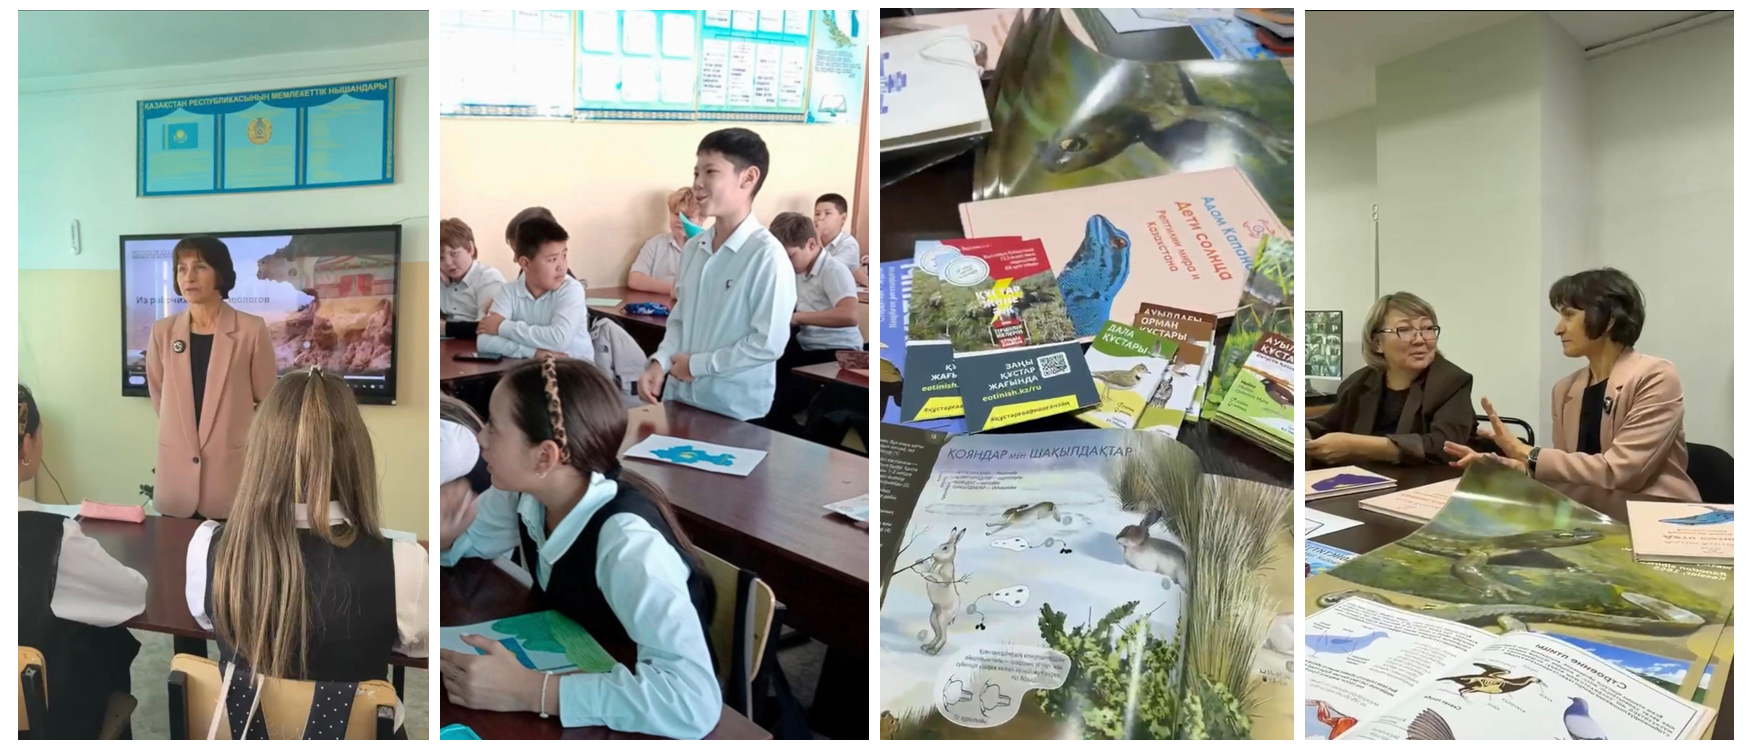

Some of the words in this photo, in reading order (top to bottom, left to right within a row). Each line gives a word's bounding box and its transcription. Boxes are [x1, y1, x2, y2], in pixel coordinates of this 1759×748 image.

[144, 100, 188, 111] ҚАЗАҚСТАН
[188, 93, 270, 107] РЕСПУБЛИКАСЫНЫҢ
[271, 87, 327, 100] МЕМЛЕКЕТТІК
[1156, 209, 1182, 248] Рептилии
[1177, 249, 1197, 273] мира
[1175, 201, 1203, 231] Дети
[1196, 232, 1234, 281] солнца
[1201, 196, 1228, 226] Адам
[1222, 227, 1254, 272] Капано
[1146, 221, 1180, 273] Казахстана
[136, 296, 148, 304] Из
[1108, 322, 1135, 338] ДАЛА
[1140, 316, 1179, 330] ОРМАН
[1102, 332, 1149, 355] ҚҰСТАРЫ
[1005, 358, 1034, 370] ЗАҢЫ
[1000, 367, 1037, 381] ҚҰСТАР
[988, 375, 1039, 392] ЖАҒЫНДА
[982, 384, 1042, 402] eotinish.kz/ru
[947, 448, 1008, 462] ҚОЯНДАР
[1029, 446, 1133, 459] ШАҚЫЛДАҚТАР
